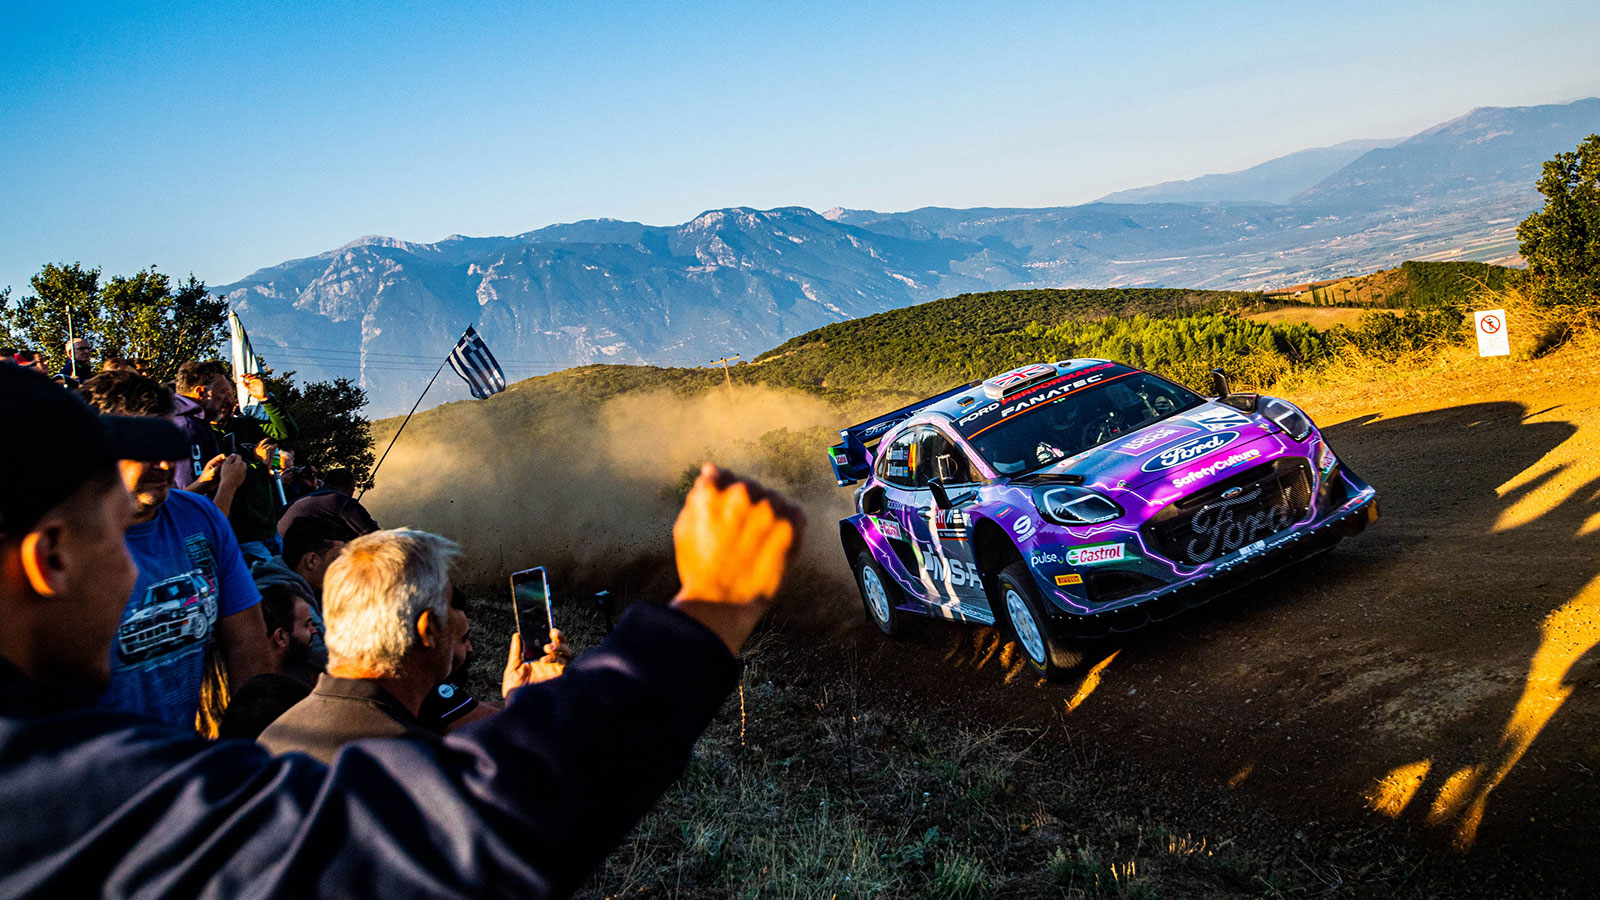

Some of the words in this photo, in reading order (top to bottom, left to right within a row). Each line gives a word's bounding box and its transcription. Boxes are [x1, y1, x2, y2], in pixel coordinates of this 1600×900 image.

[959, 402, 1000, 427] FORD
[1000, 362, 1115, 406] PERFORMANCE
[1001, 374, 1104, 418] FANATEC
[1160, 435, 1225, 467] Ford
[1172, 448, 1261, 489] SafetyCulture
[1031, 552, 1058, 568] pulse
[1080, 545, 1121, 563] Castrol
